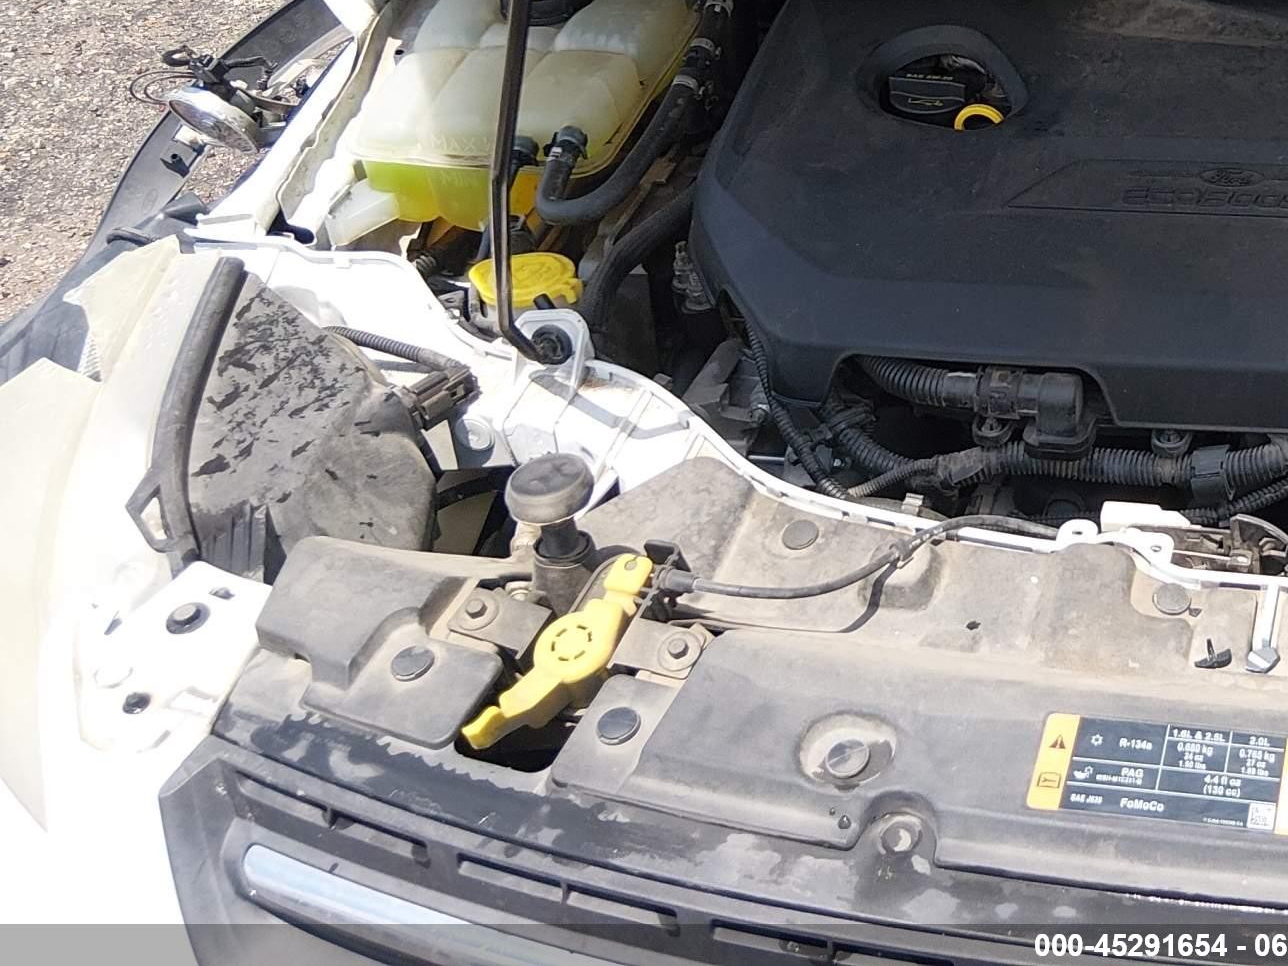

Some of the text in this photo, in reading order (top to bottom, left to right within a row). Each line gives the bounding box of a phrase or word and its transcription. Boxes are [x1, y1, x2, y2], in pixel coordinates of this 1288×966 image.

[1119, 737, 1153, 751] R-134a
[1249, 736, 1270, 747] 2.0L
[1201, 744, 1214, 757] kg
[1263, 751, 1276, 763] kg
[1121, 767, 1144, 778] PAG
[1204, 774, 1219, 785] 4.4
[1229, 778, 1242, 787] oz
[1203, 784, 1241, 798] (130 cc)
[1120, 797, 1165, 813] FoMoCo
